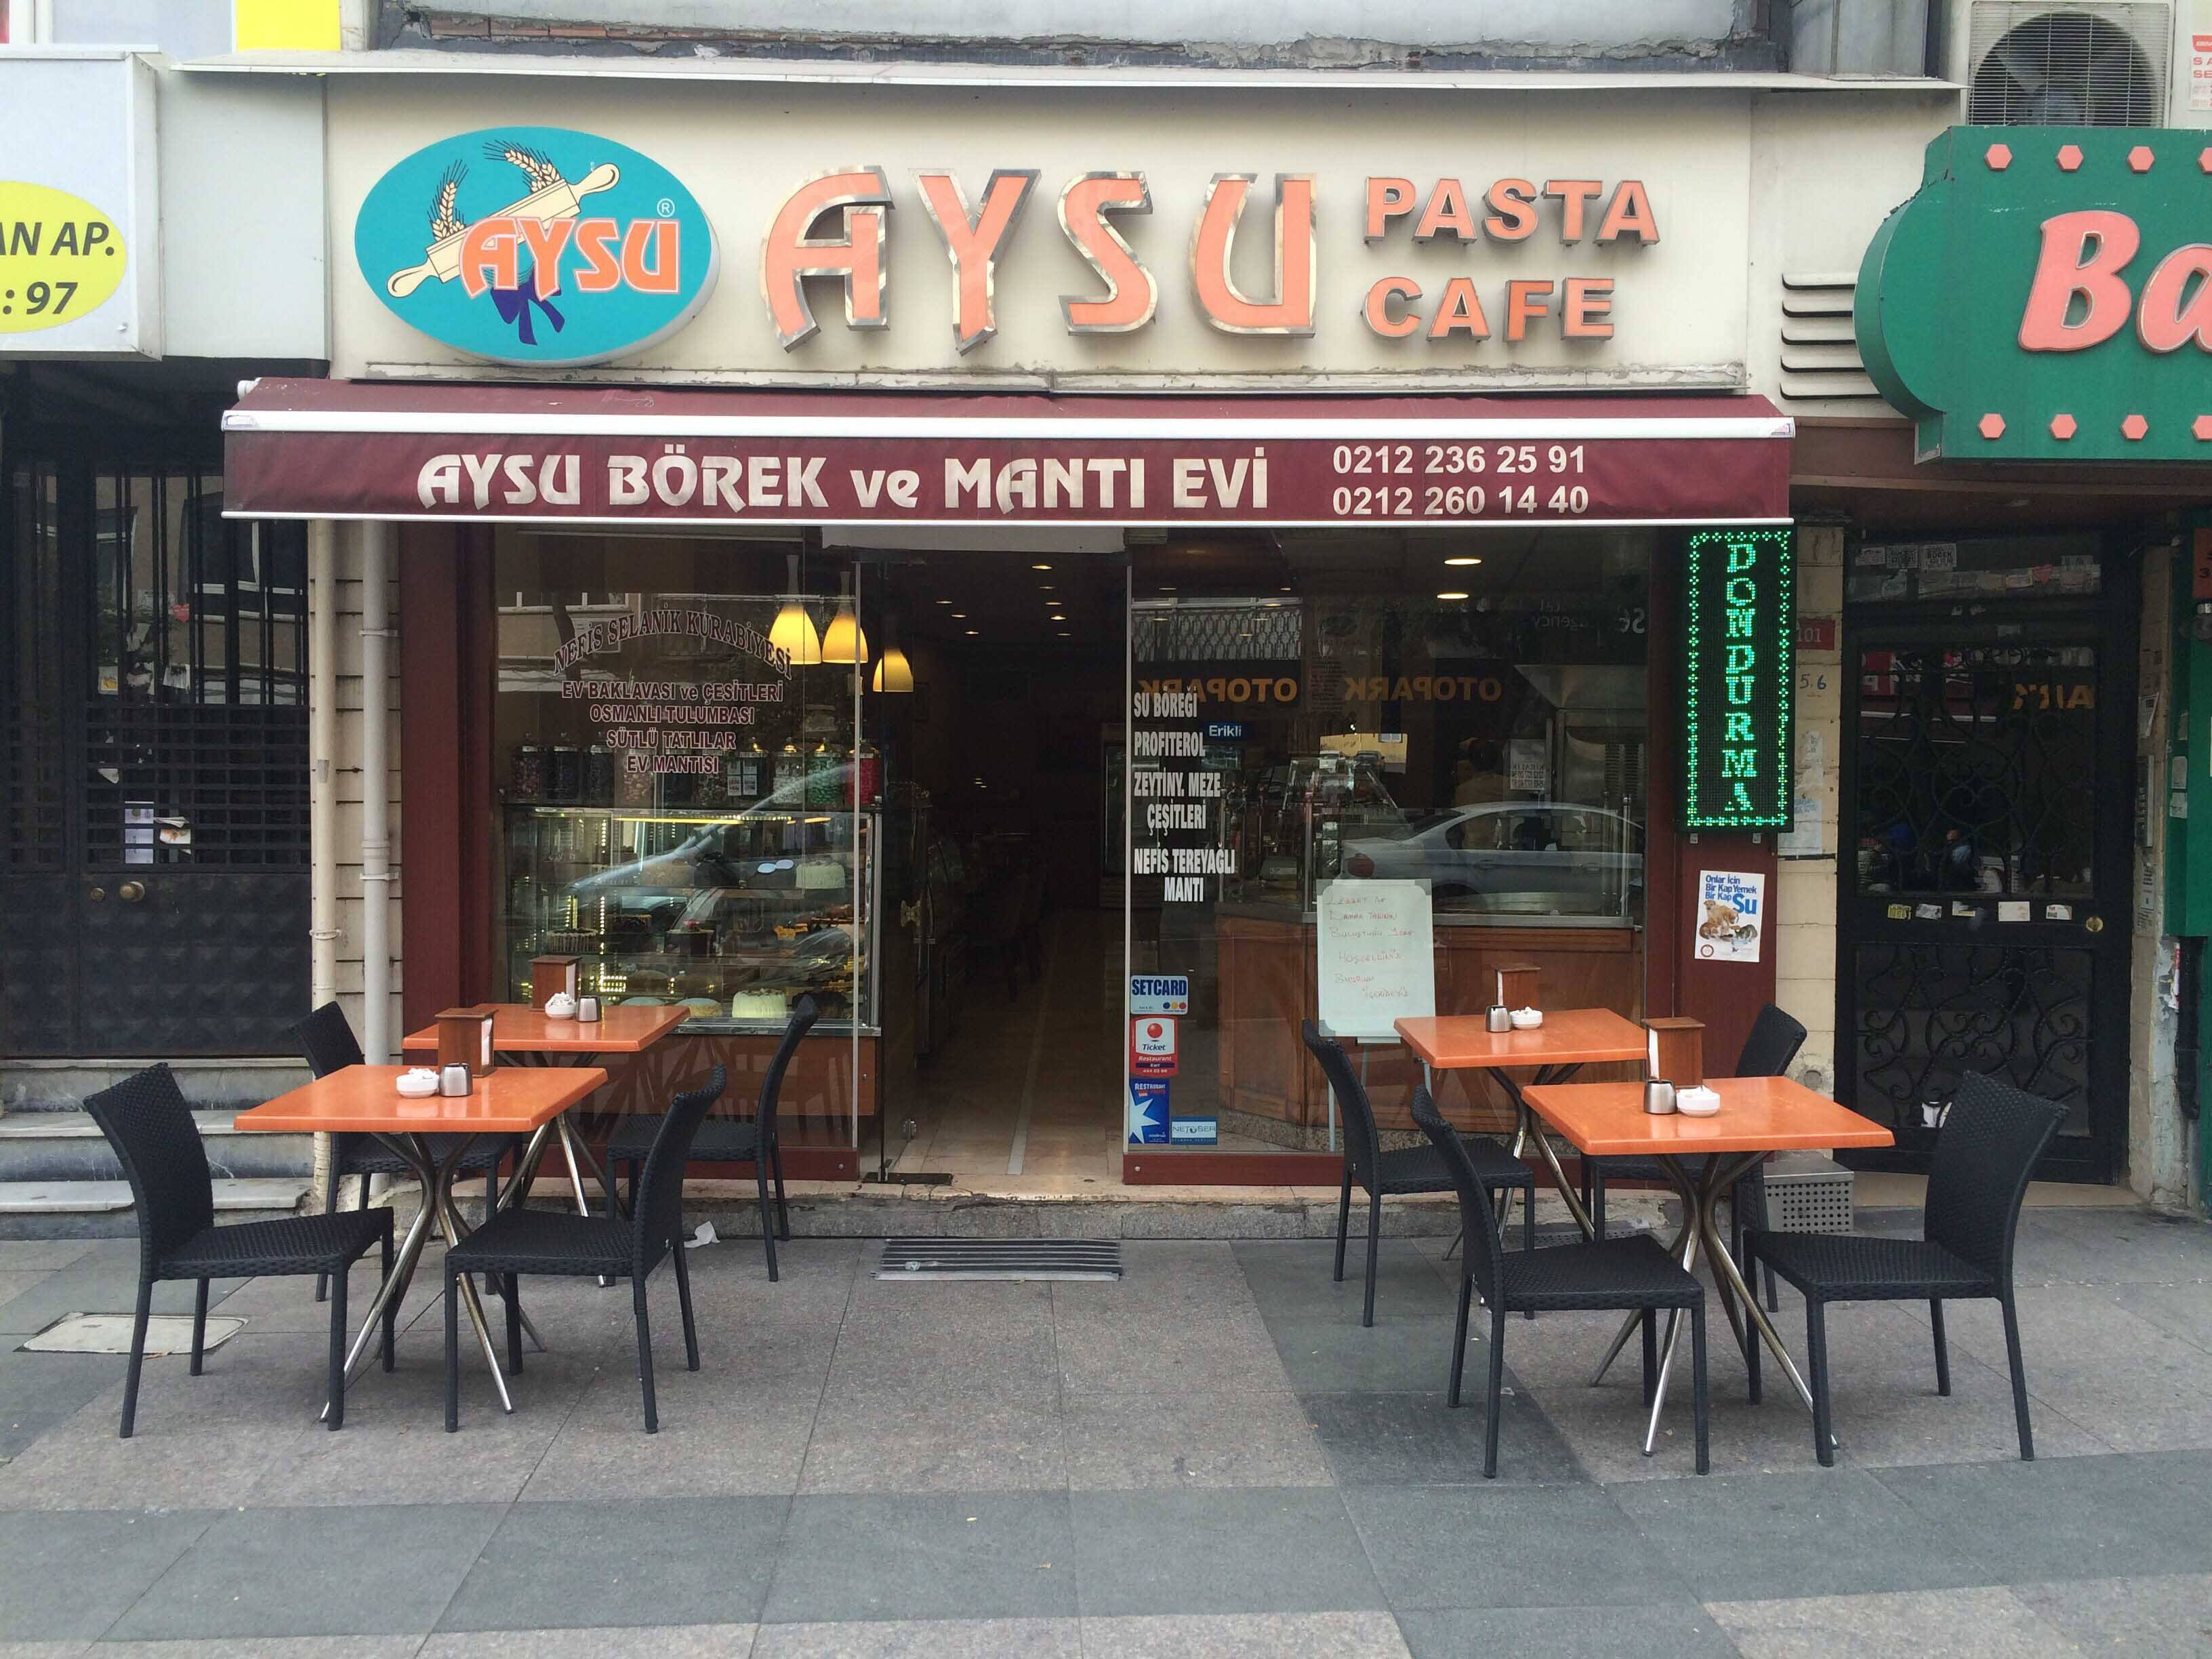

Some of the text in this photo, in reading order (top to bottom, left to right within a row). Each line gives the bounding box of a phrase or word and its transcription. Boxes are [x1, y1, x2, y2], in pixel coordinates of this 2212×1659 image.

[1364, 176, 1660, 245] PASTA
[0, 222, 115, 256] N AP.
[459, 217, 680, 300] AYSU
[760, 165, 1317, 355] AYSU
[26, 281, 78, 314] 97
[1361, 276, 1615, 342] CAFE
[1333, 445, 1583, 473] 0212 236 25 91
[417, 444, 1268, 515] AYSU BÖREK ve MANTI EVİ
[1333, 485, 1589, 515] 0212 260 14 40
[553, 622, 603, 676] NEFİS
[687, 611, 792, 680] KURABİYESİ
[561, 680, 583, 699] EV
[588, 681, 676, 700] BAKLAVASI
[680, 687, 698, 700] ve
[1721, 542, 1758, 811] DONDURMA
[590, 704, 755, 724] OSMANLI TULUMBASI
[1134, 686, 1197, 718] SU BÖREĞİ
[606, 726, 737, 750] SÜTLÜ TATLILAR
[1134, 732, 1206, 757] PROFITEROL
[1208, 725, 1242, 737] Erikli
[627, 756, 719, 774] EV MANTISI
[1134, 767, 1221, 797] ZEYTİNY. MEZE
[1147, 798, 1206, 836] ÇEŞİTLERİ
[1134, 842, 1235, 874] NEFİS TEREYAĞLI
[1164, 877, 1204, 902] MANTI
[1706, 875, 1725, 884] Onlar
[1718, 884, 1732, 893] Kap
[1733, 886, 1757, 894] Yemek
[1717, 893, 1732, 902] Kap
[1733, 893, 1757, 914] Su
[1132, 979, 1187, 996] SETCARD
